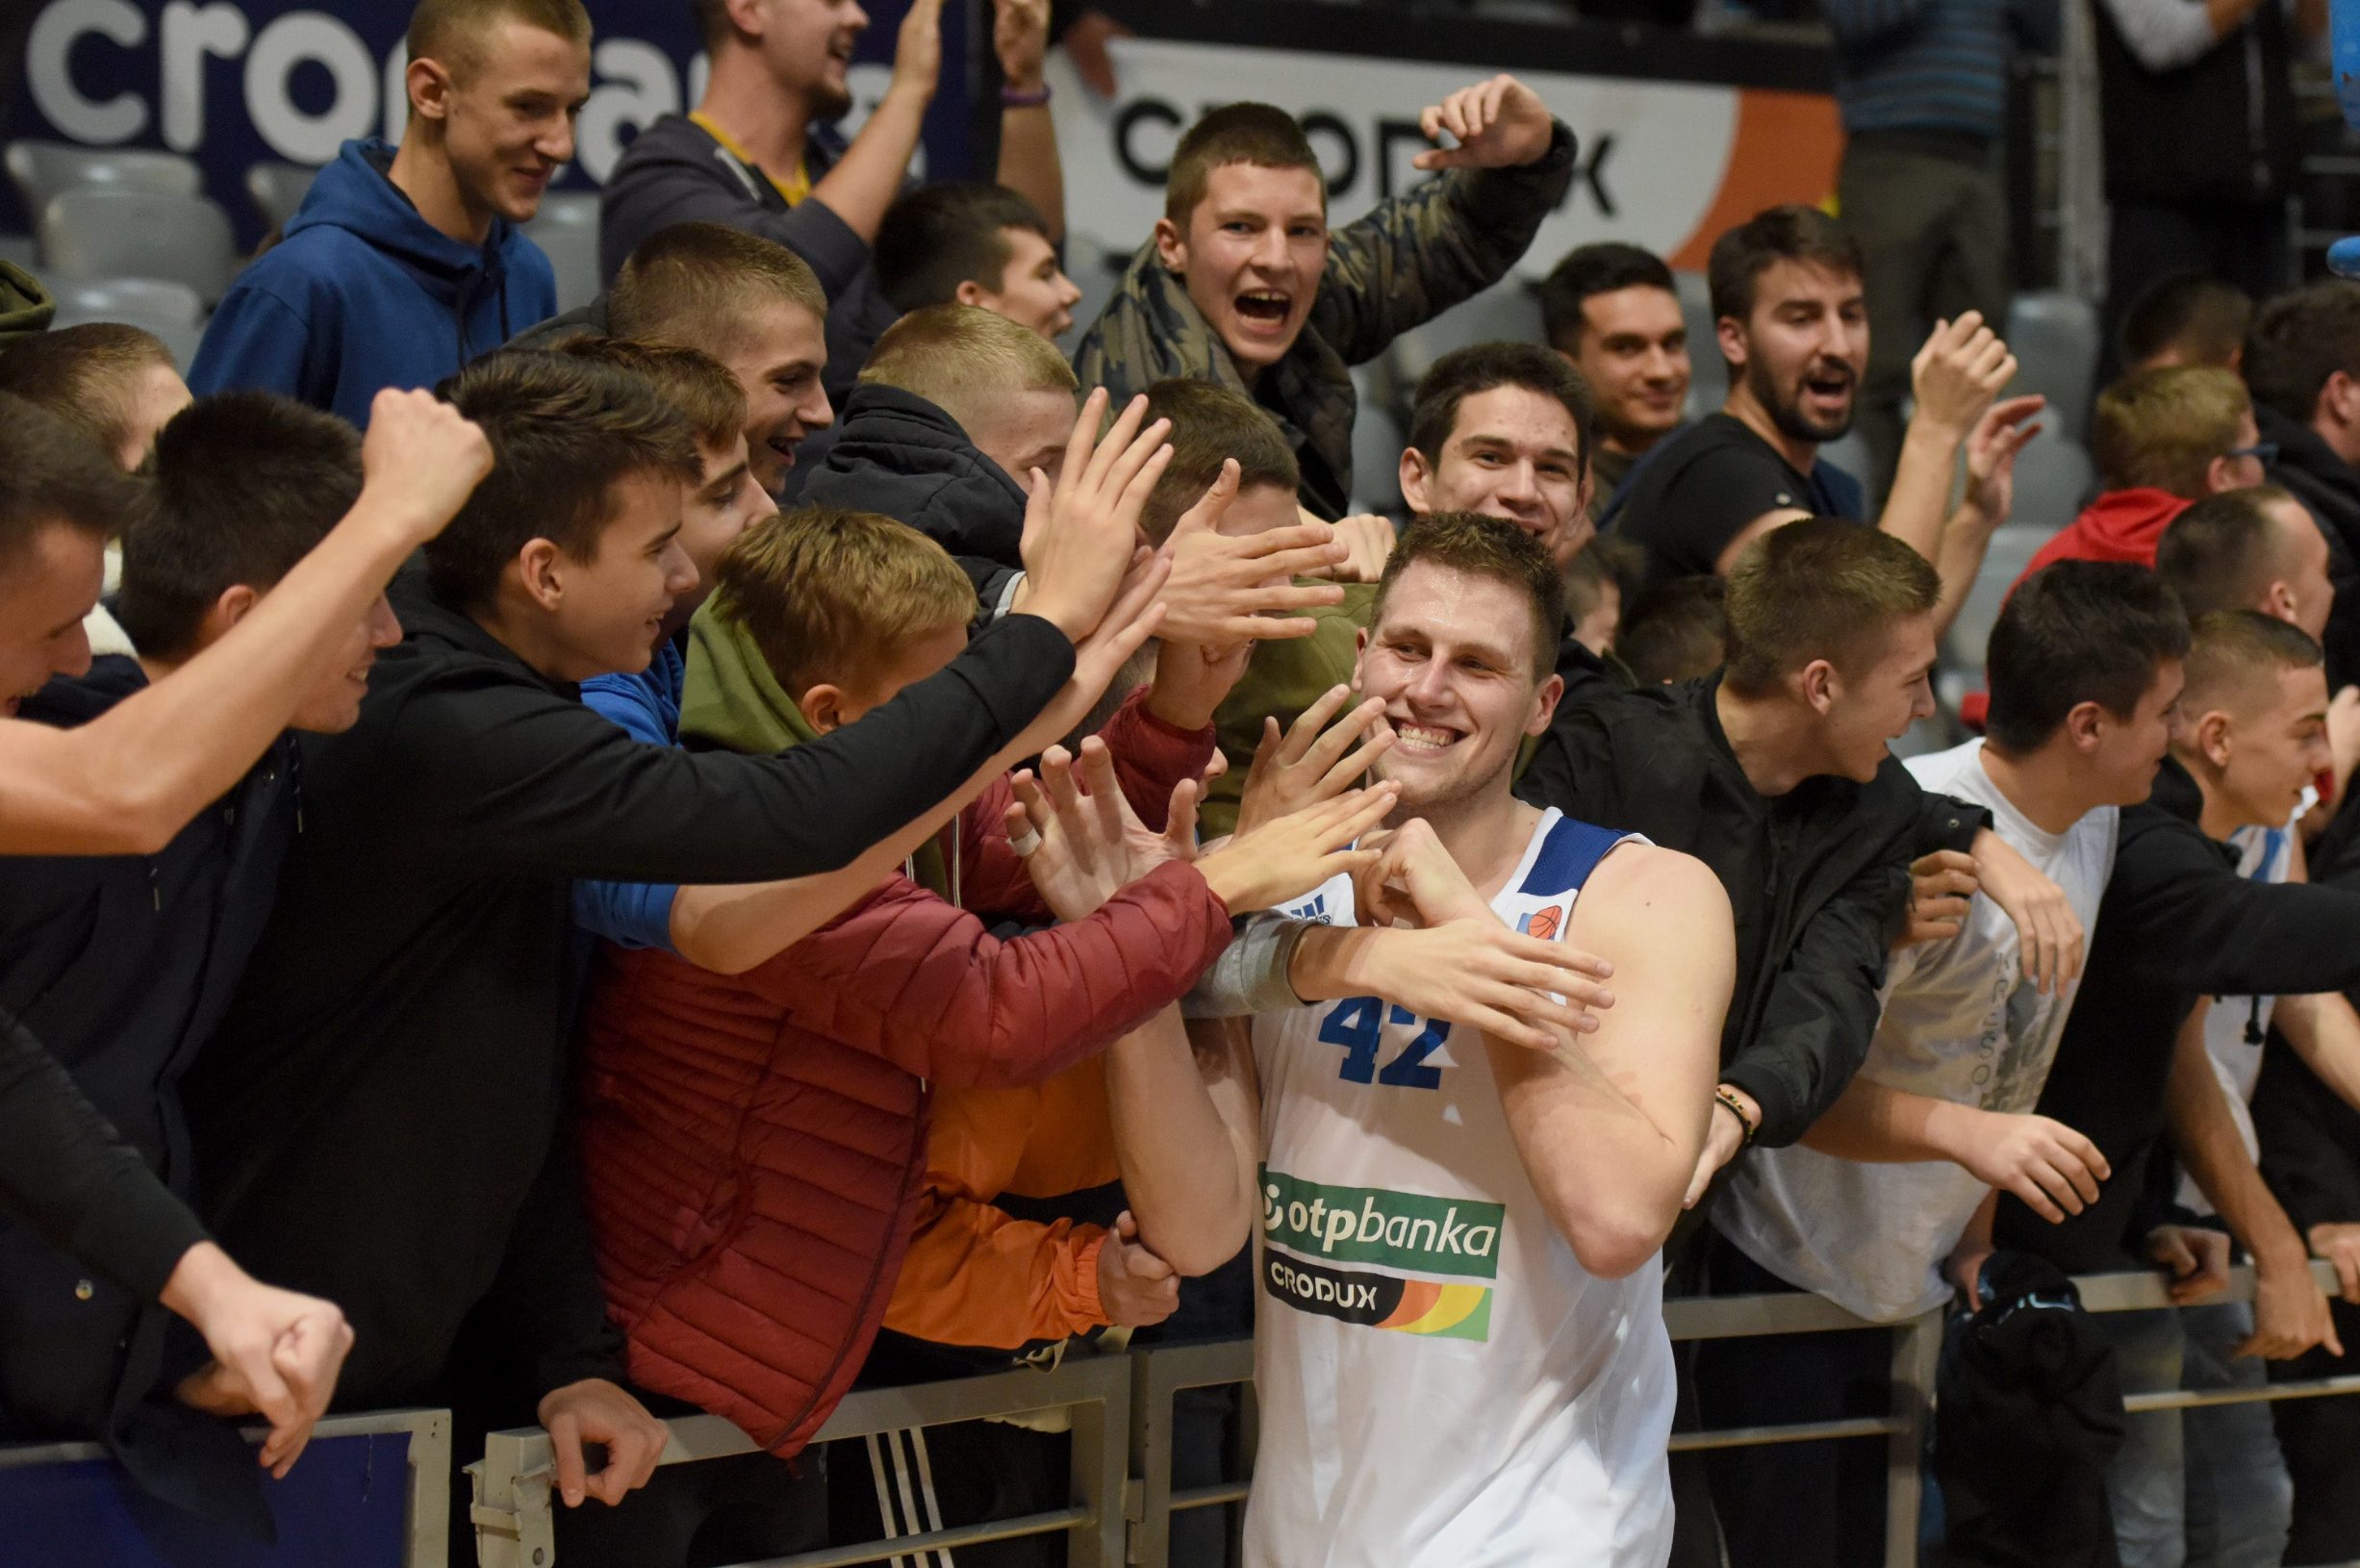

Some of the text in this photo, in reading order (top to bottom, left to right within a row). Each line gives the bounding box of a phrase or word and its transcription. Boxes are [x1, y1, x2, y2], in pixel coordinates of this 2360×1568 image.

[1113, 96, 1617, 217] CODX
[1318, 996, 1451, 1090] 42
[1270, 1261, 1378, 1311] CRODUX
